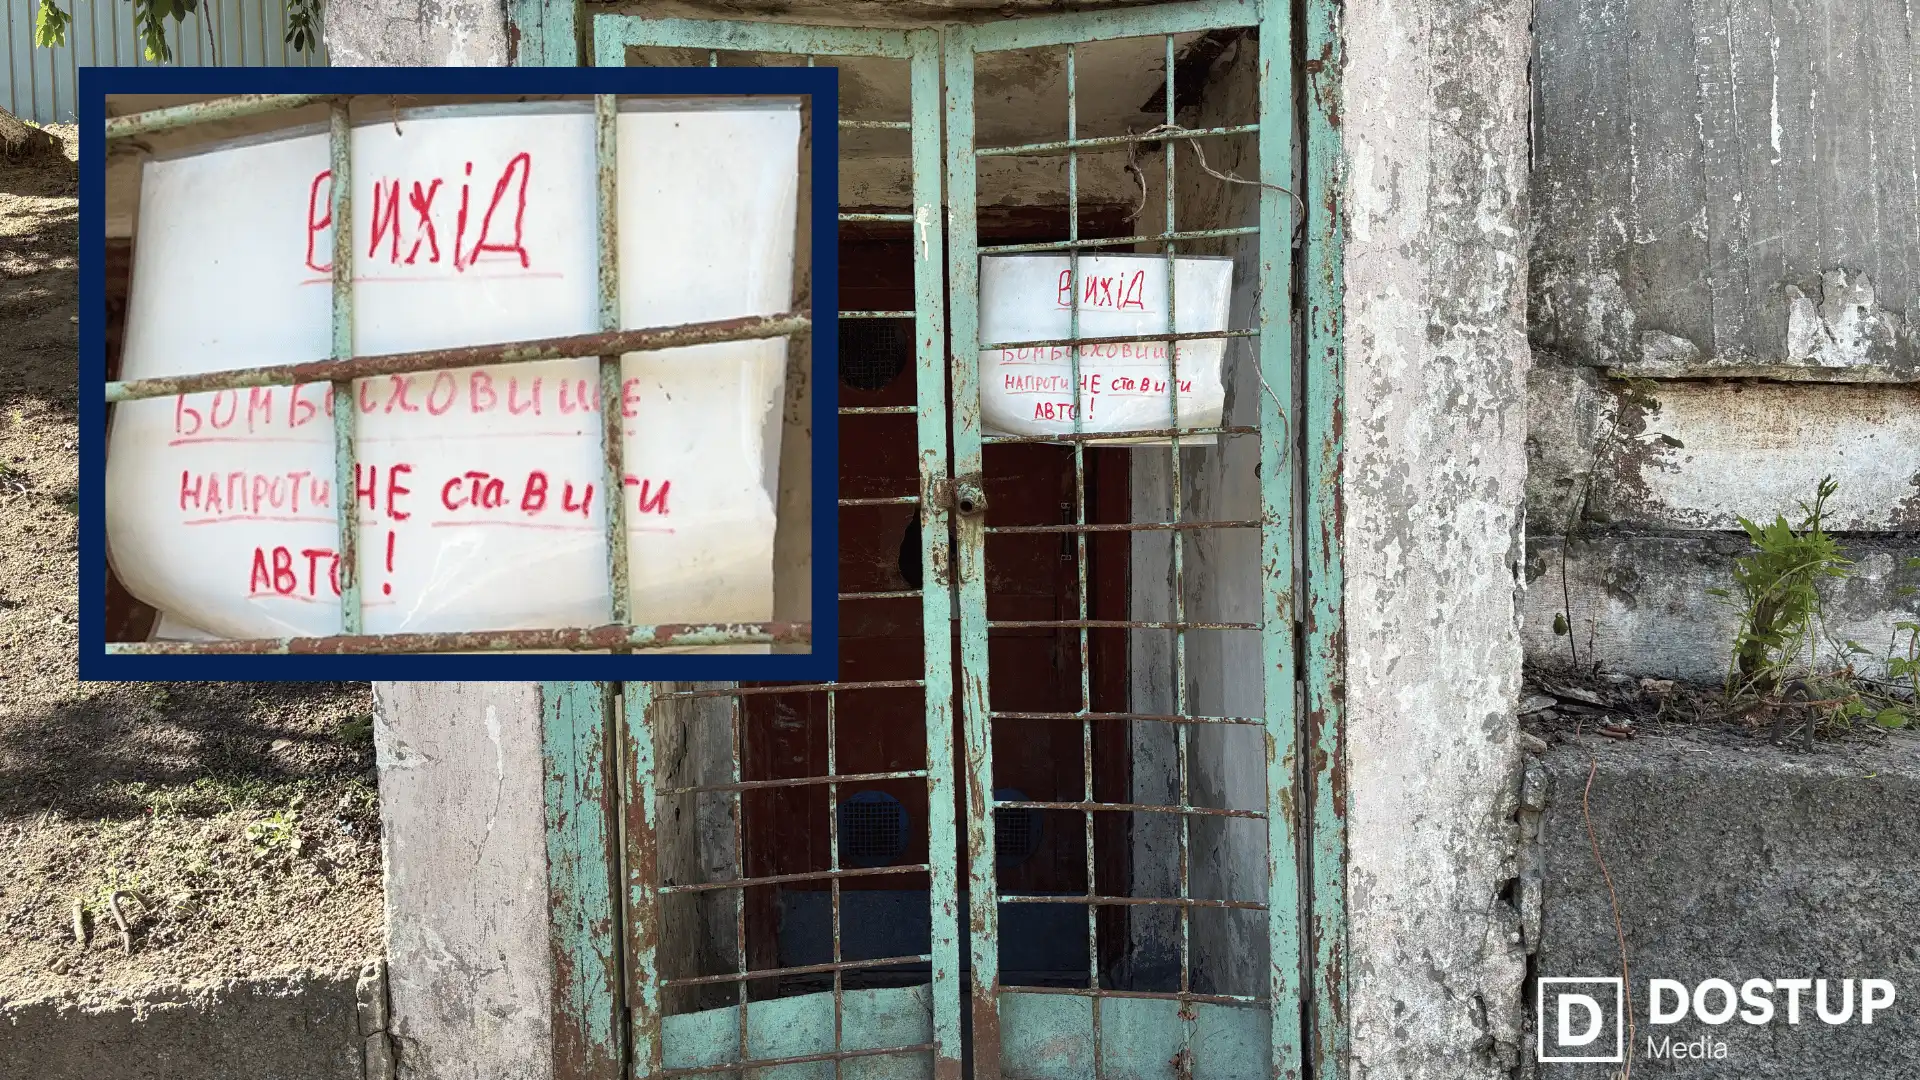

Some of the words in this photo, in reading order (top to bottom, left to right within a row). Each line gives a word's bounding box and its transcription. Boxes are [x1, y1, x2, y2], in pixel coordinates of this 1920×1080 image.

[1005, 374, 1069, 392] НАПРОТИ
[1079, 373, 1101, 395] НЕ
[180, 470, 331, 514] НАПРОТИ
[354, 463, 414, 521] НЕ
